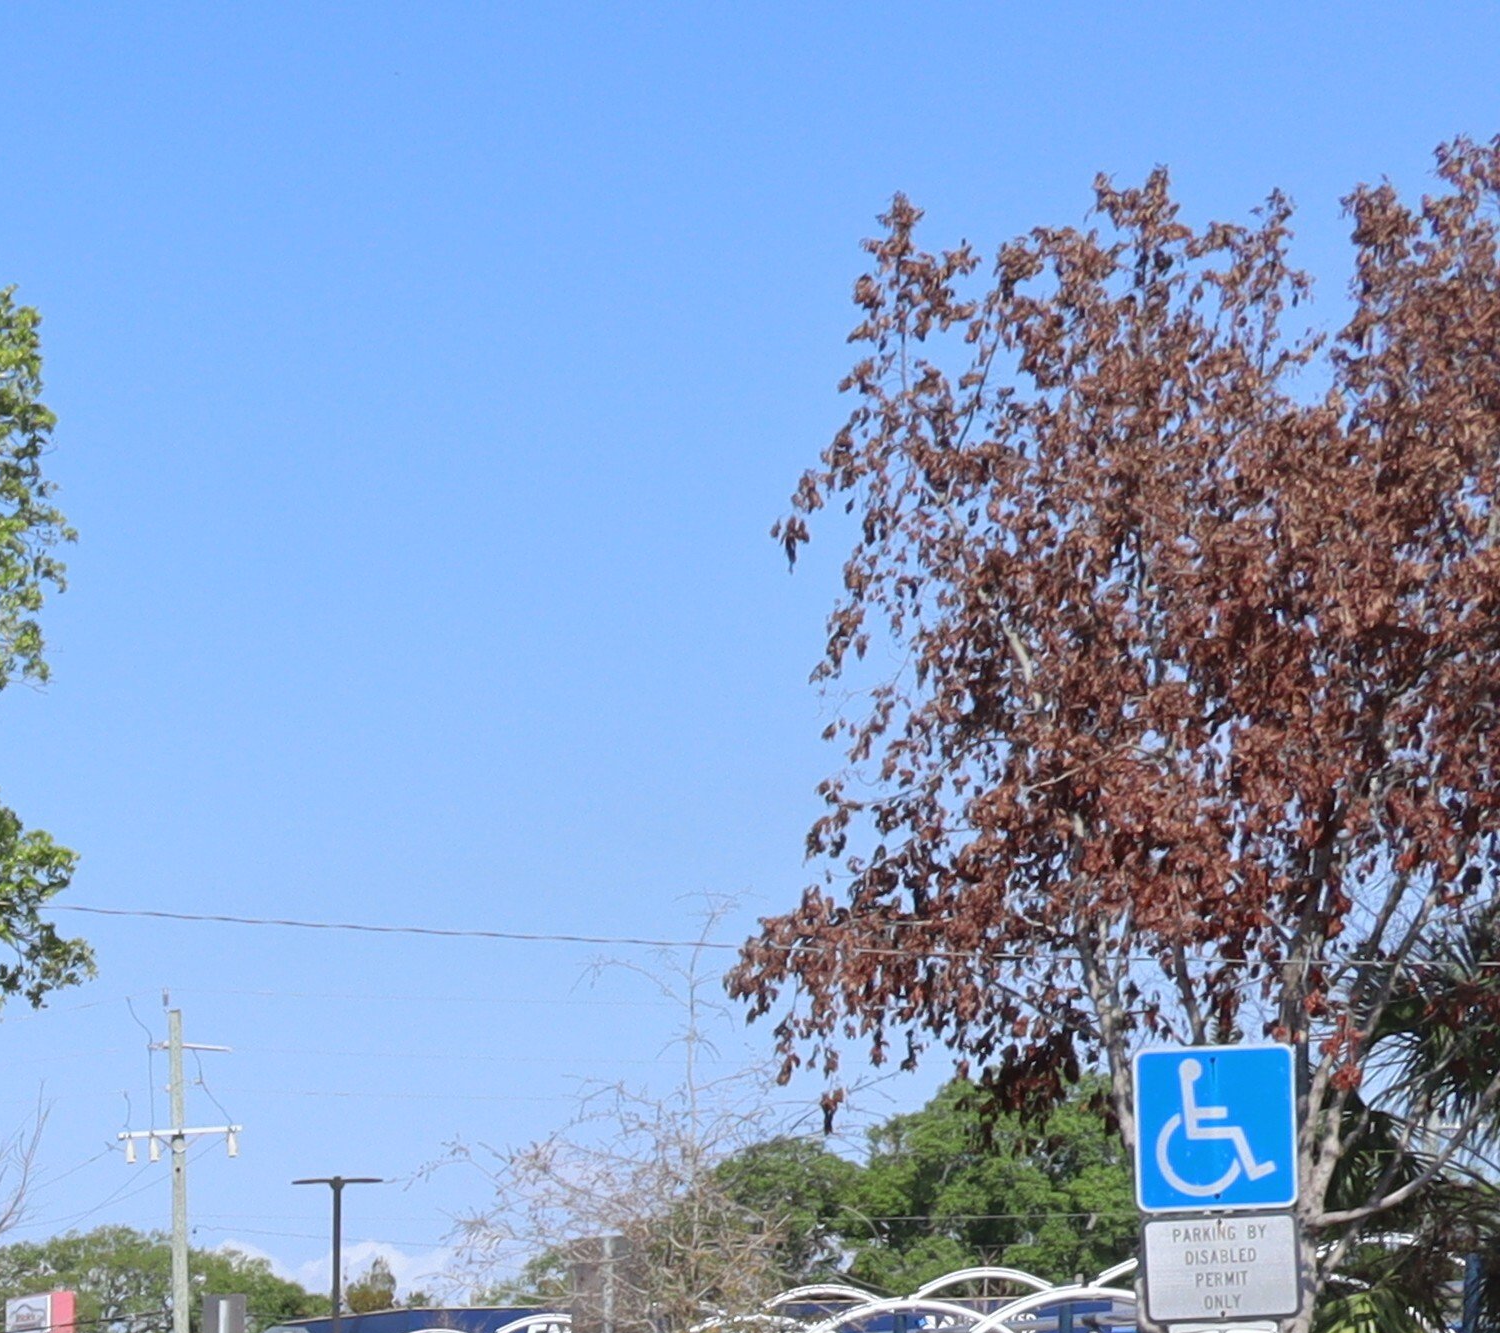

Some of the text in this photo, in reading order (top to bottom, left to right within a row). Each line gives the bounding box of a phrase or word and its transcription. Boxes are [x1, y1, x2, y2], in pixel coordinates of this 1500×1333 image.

[1172, 1224, 1268, 1243] PARKING BY
[1184, 1247, 1257, 1266] DISABLED
[1195, 1270, 1249, 1288] PERMIT
[1203, 1293, 1242, 1310] ONLY
